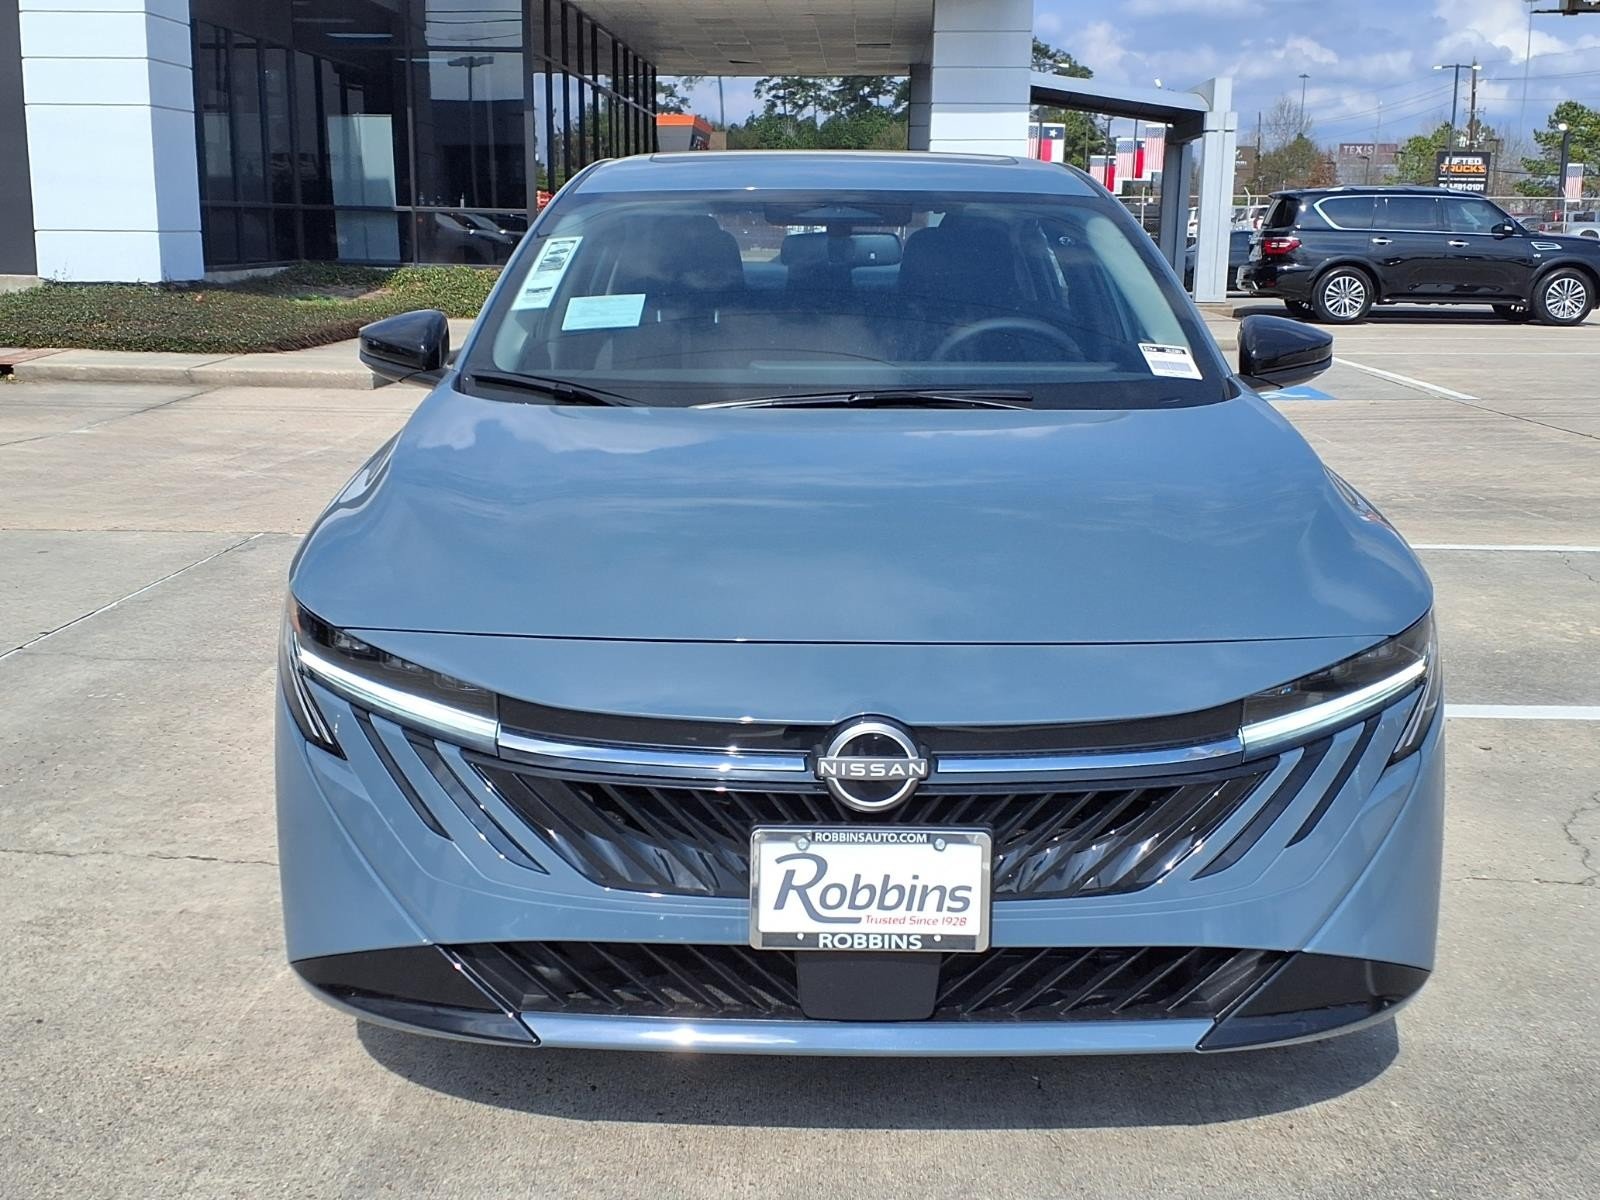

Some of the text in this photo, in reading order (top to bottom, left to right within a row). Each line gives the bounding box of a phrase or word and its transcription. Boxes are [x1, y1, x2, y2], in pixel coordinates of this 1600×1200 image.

[1440, 164, 1487, 174] TRUCKS
[820, 761, 926, 777] NISSAN
[814, 832, 928, 843] ROBBINSAUTO.COM
[773, 852, 973, 925] Robbins
[865, 915, 968, 927] Trusted Since 1928
[818, 933, 923, 950] ROBBINS
